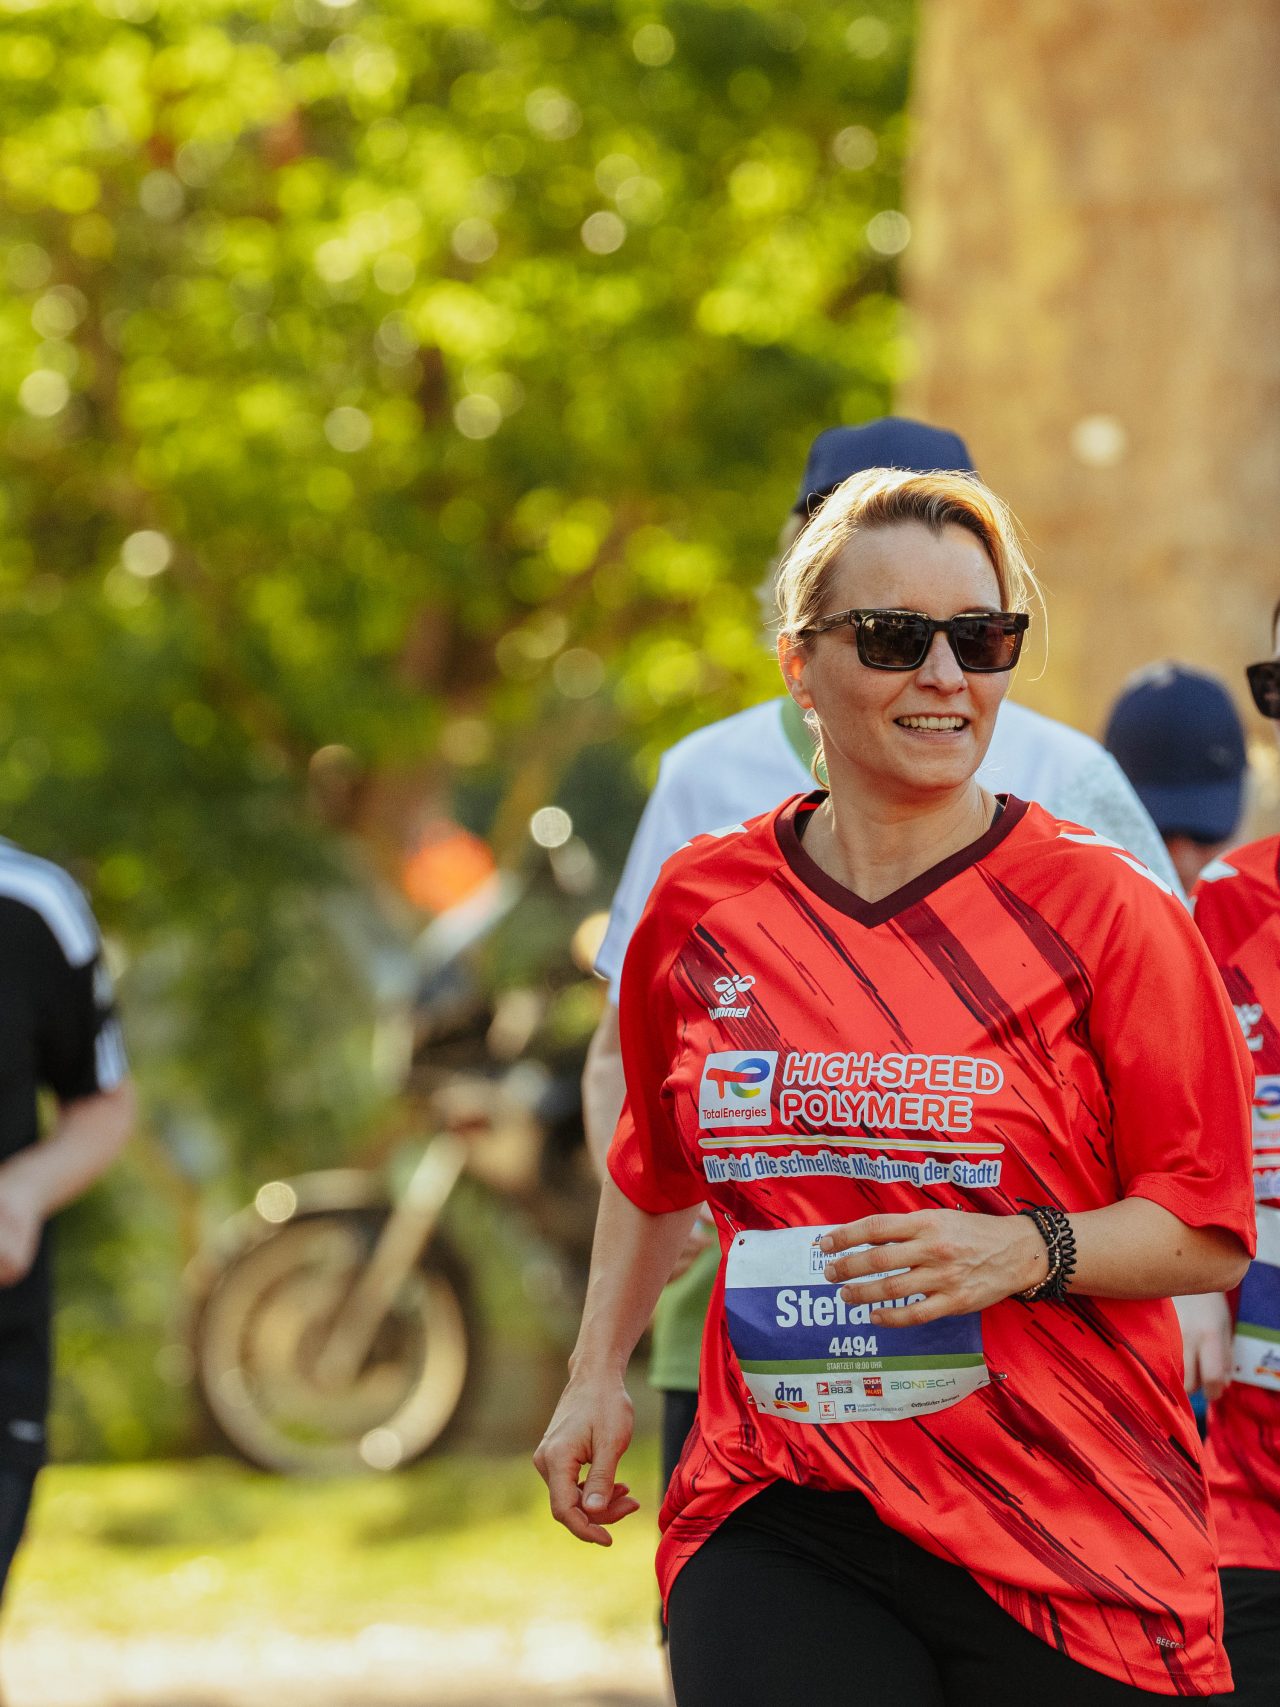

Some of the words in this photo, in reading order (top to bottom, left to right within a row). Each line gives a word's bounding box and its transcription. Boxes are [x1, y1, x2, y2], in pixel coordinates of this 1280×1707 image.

[785, 1054, 1001, 1092] HIGH-SPEED
[702, 1106, 767, 1120] TotalEnergies
[783, 1092, 972, 1130] POLYMERE
[705, 1158, 725, 1179] Wir
[755, 1155, 778, 1176] die
[780, 1153, 850, 1175] schnellste
[852, 1157, 919, 1183] Mischung
[924, 1161, 949, 1181] der
[953, 1163, 998, 1184] Stadt!
[828, 1336, 878, 1357] 4494
[775, 1382, 802, 1402] dm
[831, 1386, 853, 1394] 88.3
[890, 1379, 956, 1390] BIONTECH
